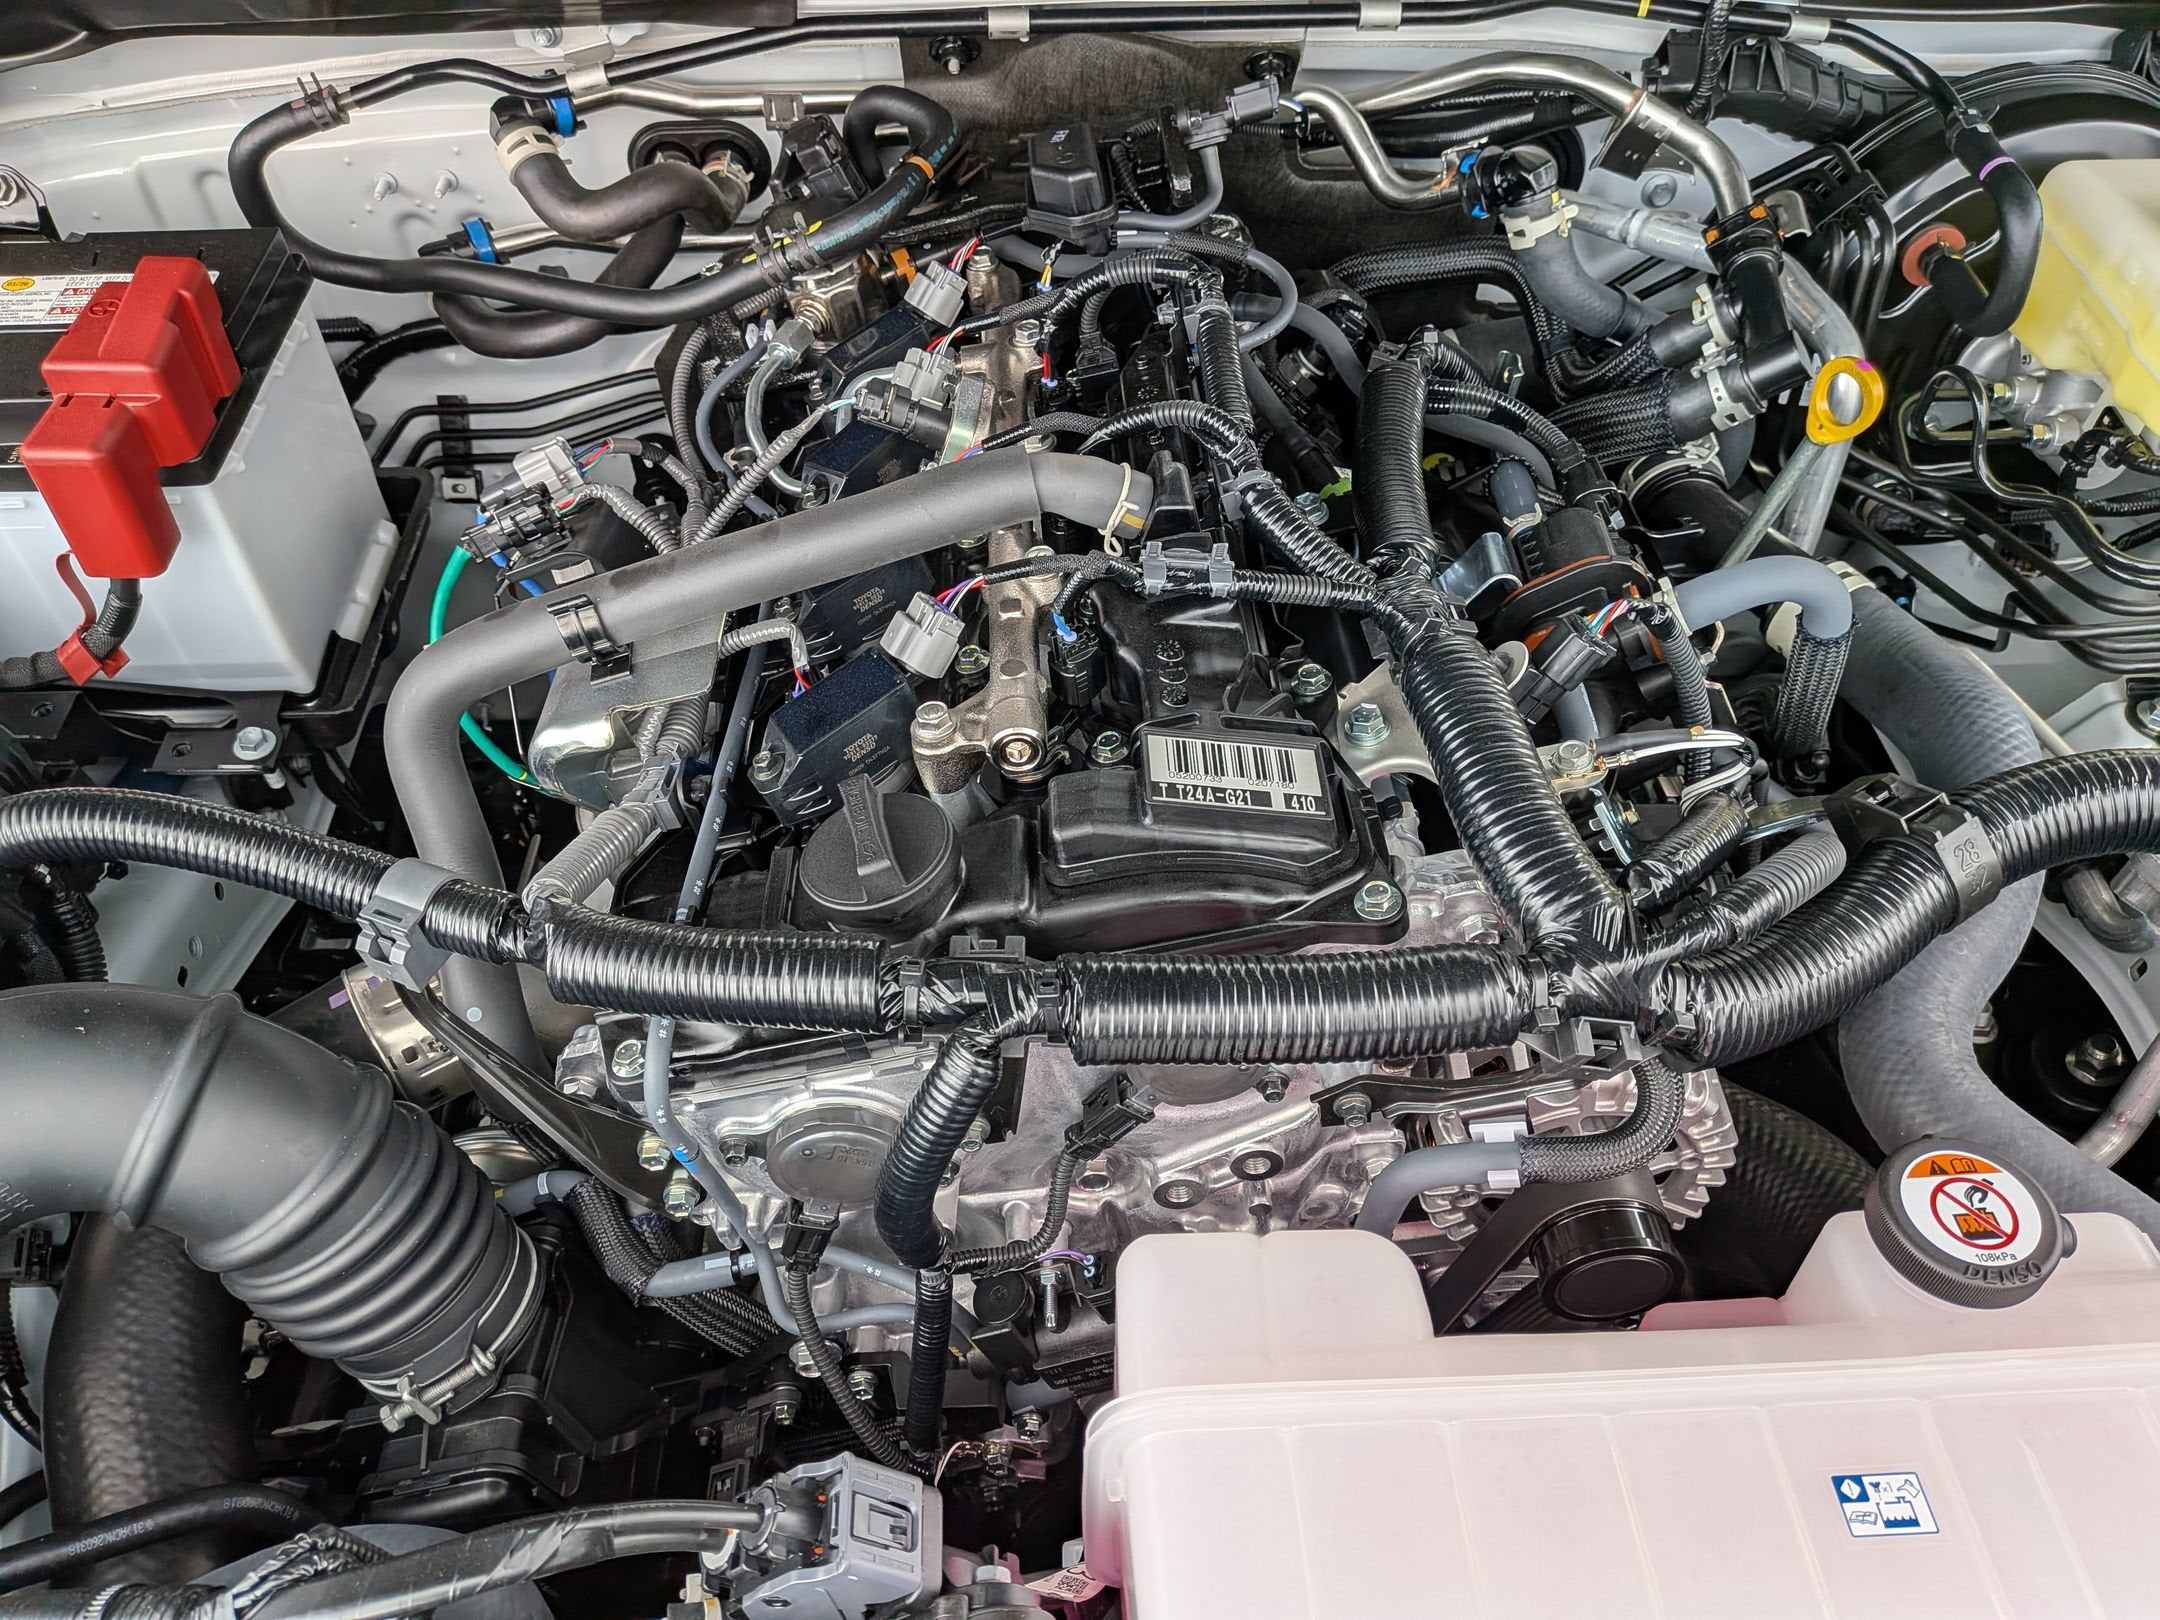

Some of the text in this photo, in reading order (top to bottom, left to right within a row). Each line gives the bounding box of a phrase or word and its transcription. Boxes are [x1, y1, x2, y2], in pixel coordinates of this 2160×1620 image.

[853, 587, 881, 605] TOYOTA
[861, 596, 882, 613] DENSO
[843, 733, 874, 753] TOYOTA
[852, 742, 876, 762] DENSO
[1168, 770, 1295, 790] 05200733 0207180
[1176, 784, 1252, 806] T24A-G21
[1291, 795, 1316, 812] 410
[1953, 837, 1980, 872] 28
[1975, 1251, 2018, 1264] 108kPa
[1963, 1260, 2043, 1286] DENSO
